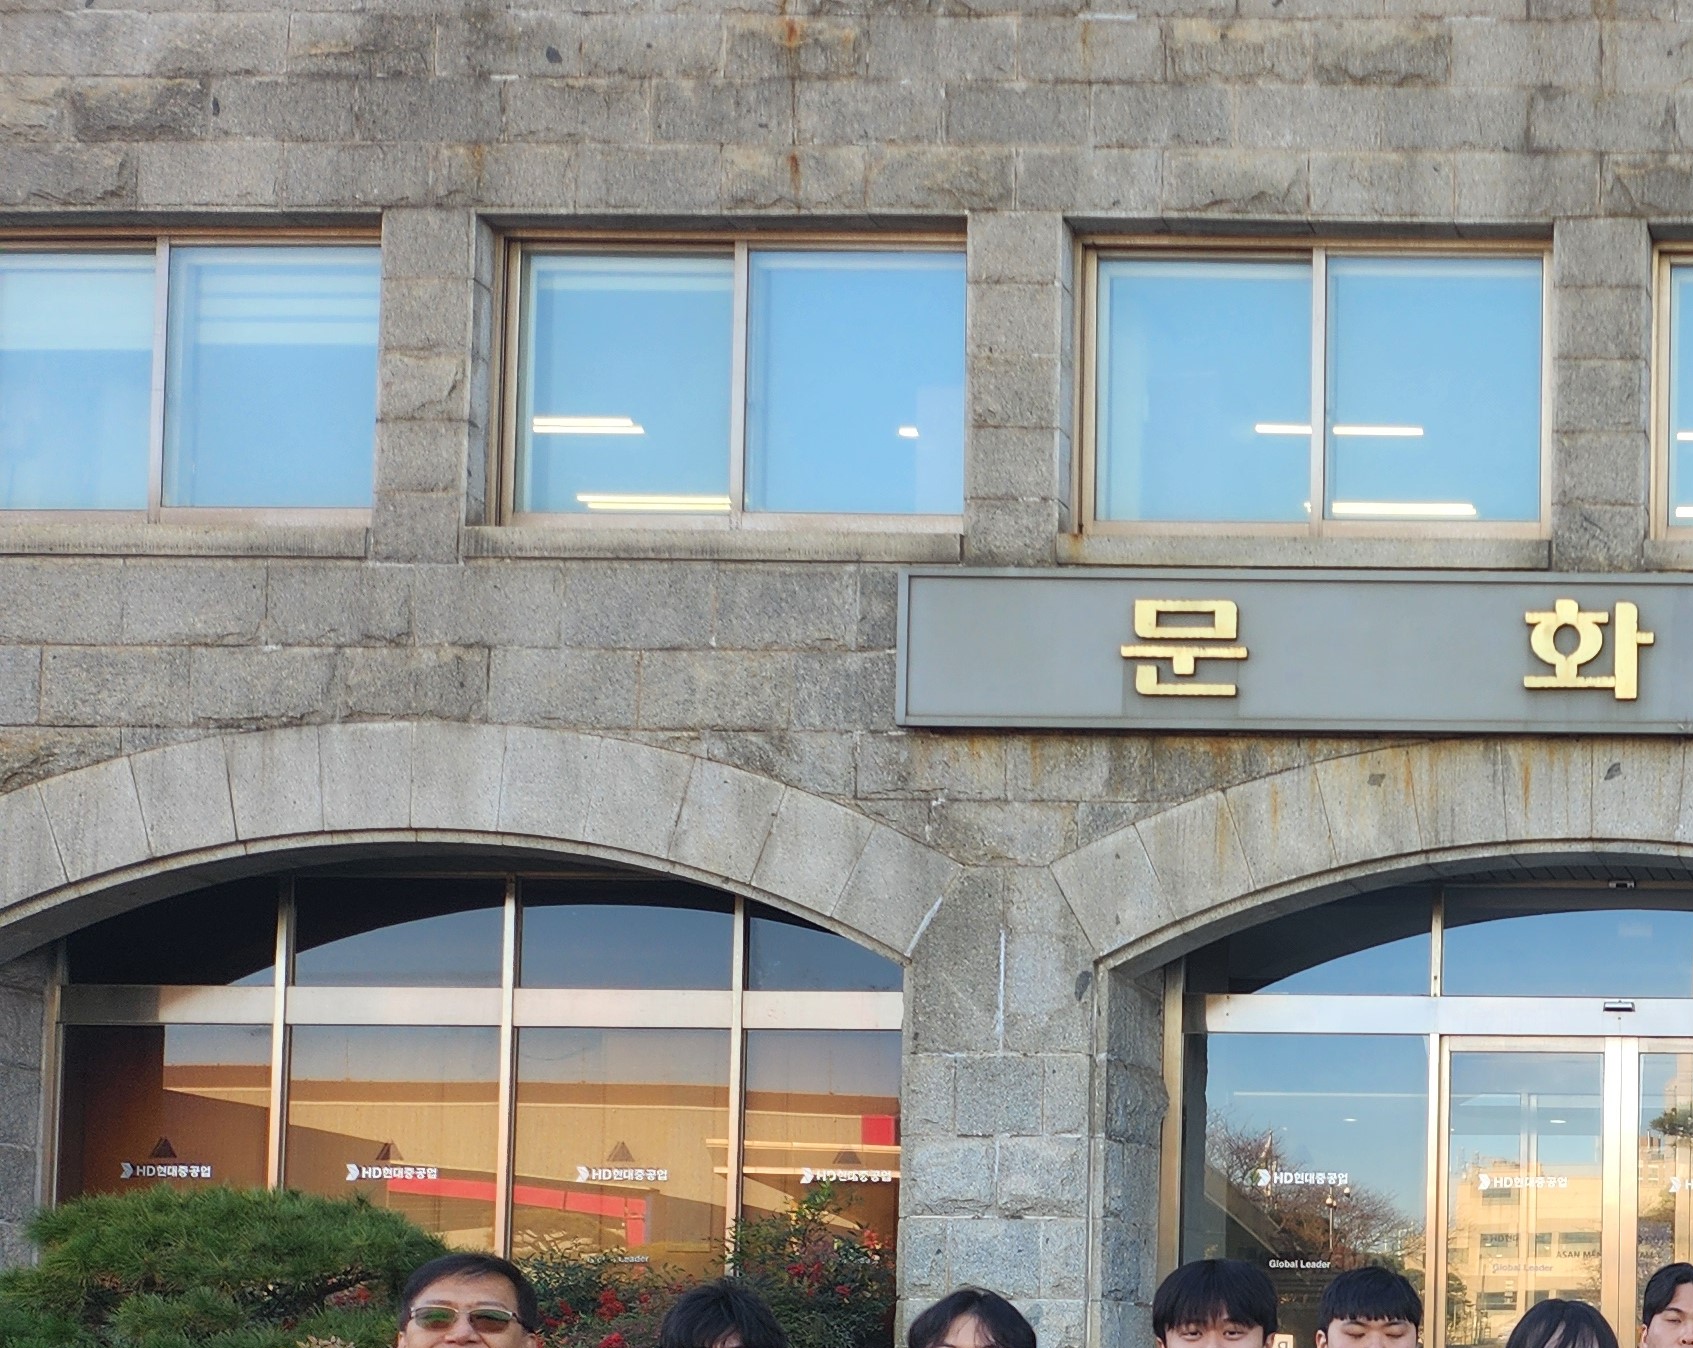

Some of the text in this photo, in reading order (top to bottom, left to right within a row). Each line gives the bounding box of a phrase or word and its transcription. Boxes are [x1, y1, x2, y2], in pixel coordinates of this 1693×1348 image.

[1121, 599, 1247, 696] 문
[1524, 598, 1654, 700] 화
[136, 1164, 212, 1178] HD현대중공업
[361, 1166, 438, 1180] HD현대중공업
[591, 1168, 669, 1182] HD현대중공업
[1273, 1171, 1349, 1186] HD현대중공업
[1493, 1176, 1568, 1189] HD현대중공업
[1268, 1259, 1331, 1270] Global Leader
[1493, 1263, 1553, 1273] Global Leader
